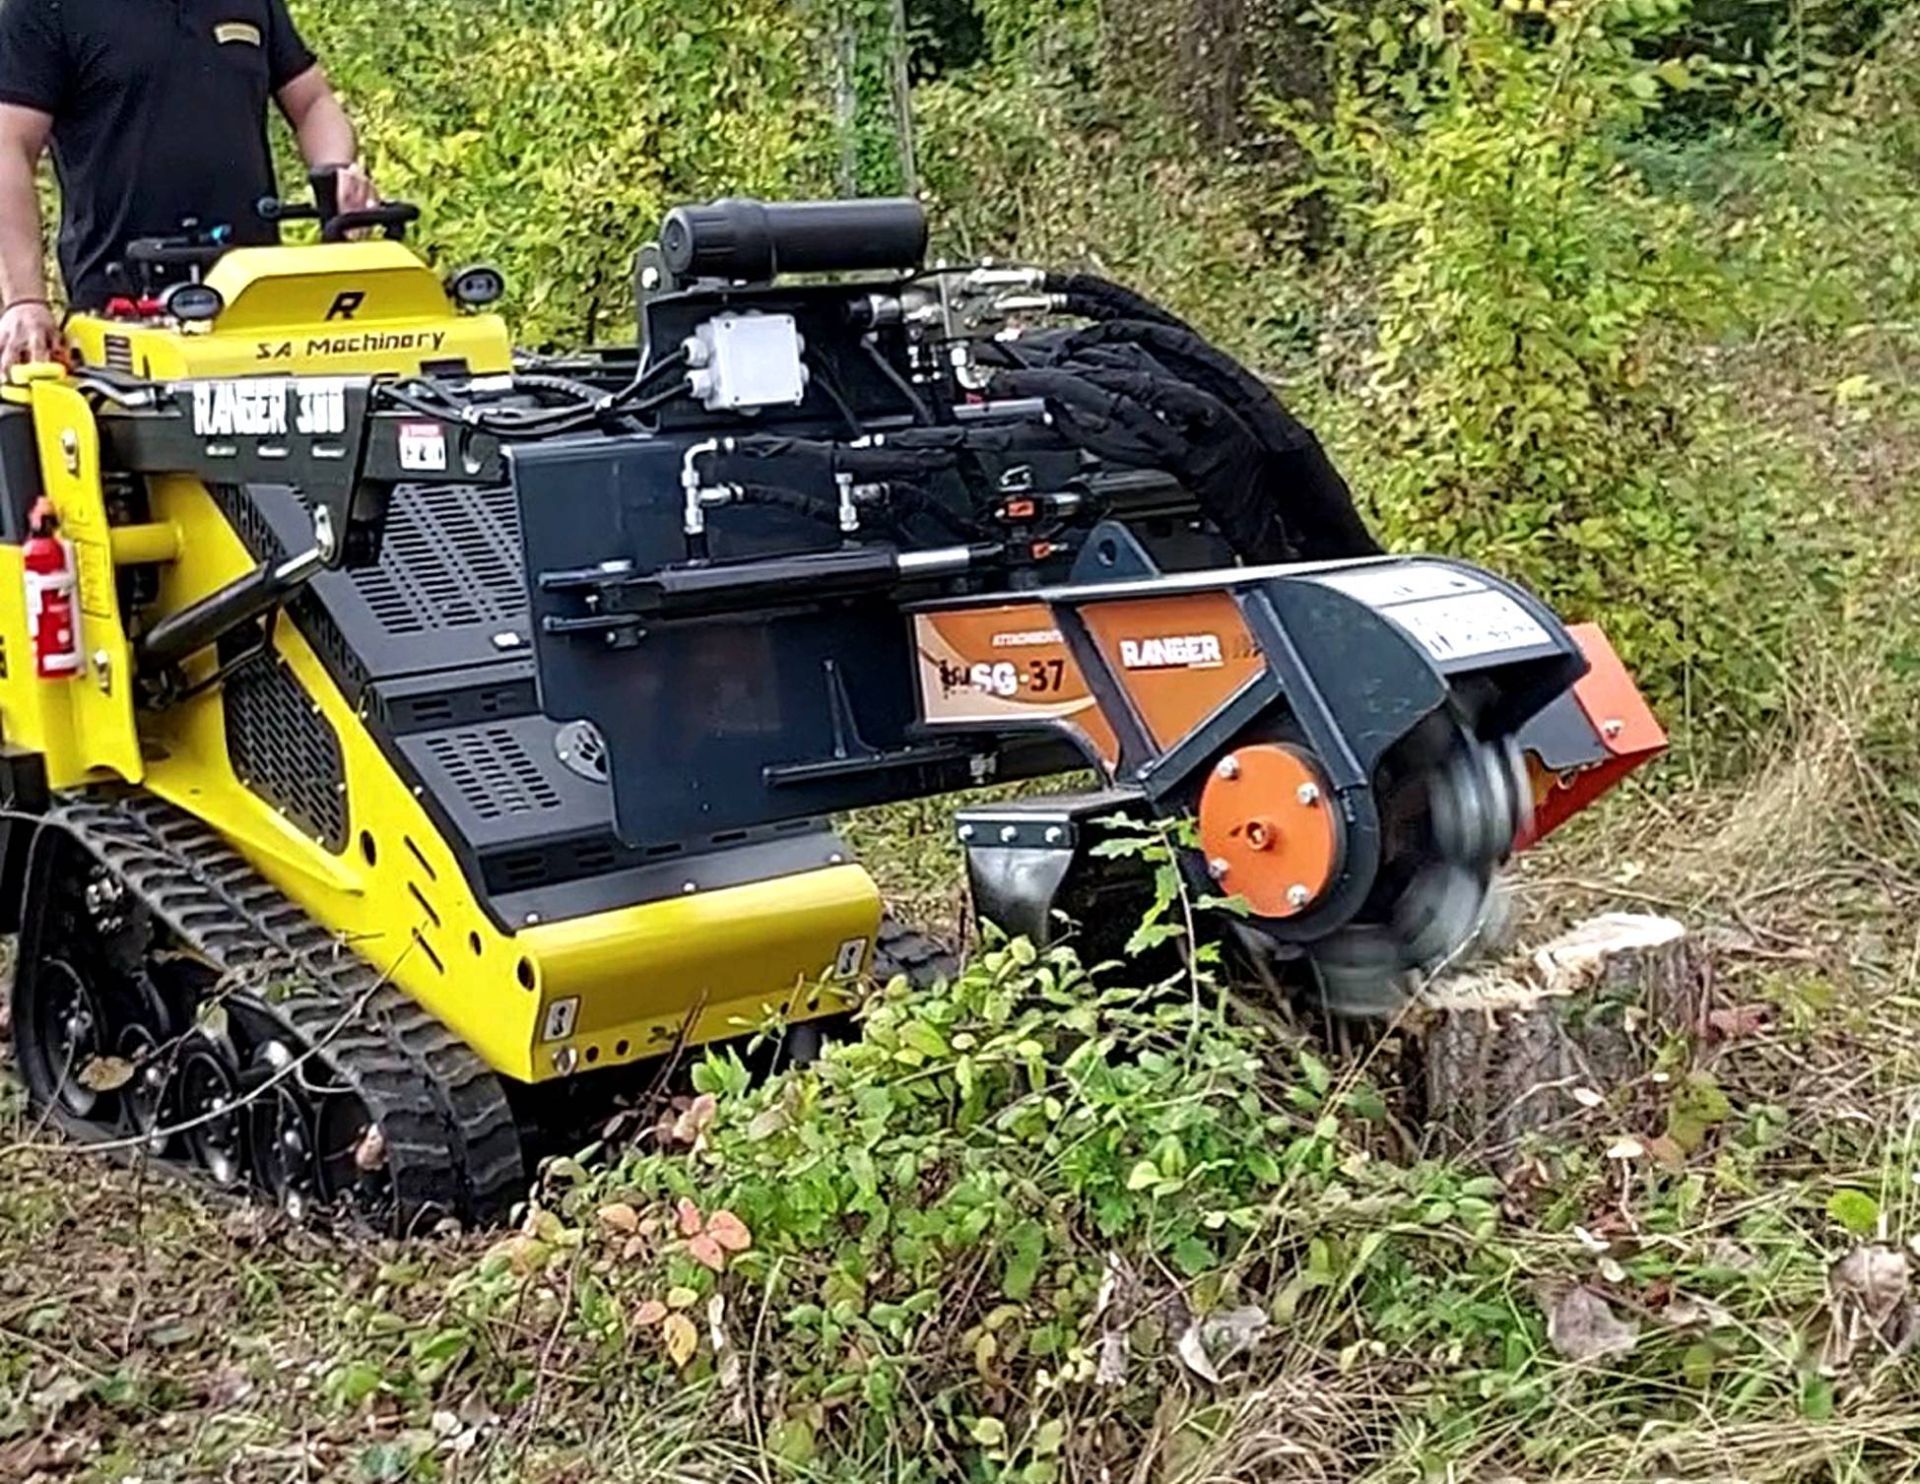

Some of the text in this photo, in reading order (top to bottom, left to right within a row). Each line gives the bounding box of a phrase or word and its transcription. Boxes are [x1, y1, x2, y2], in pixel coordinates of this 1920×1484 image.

[325, 291, 366, 321] R
[257, 342, 292, 360] SA
[192, 380, 288, 435] RANGER
[1120, 634, 1223, 668] RANGER
